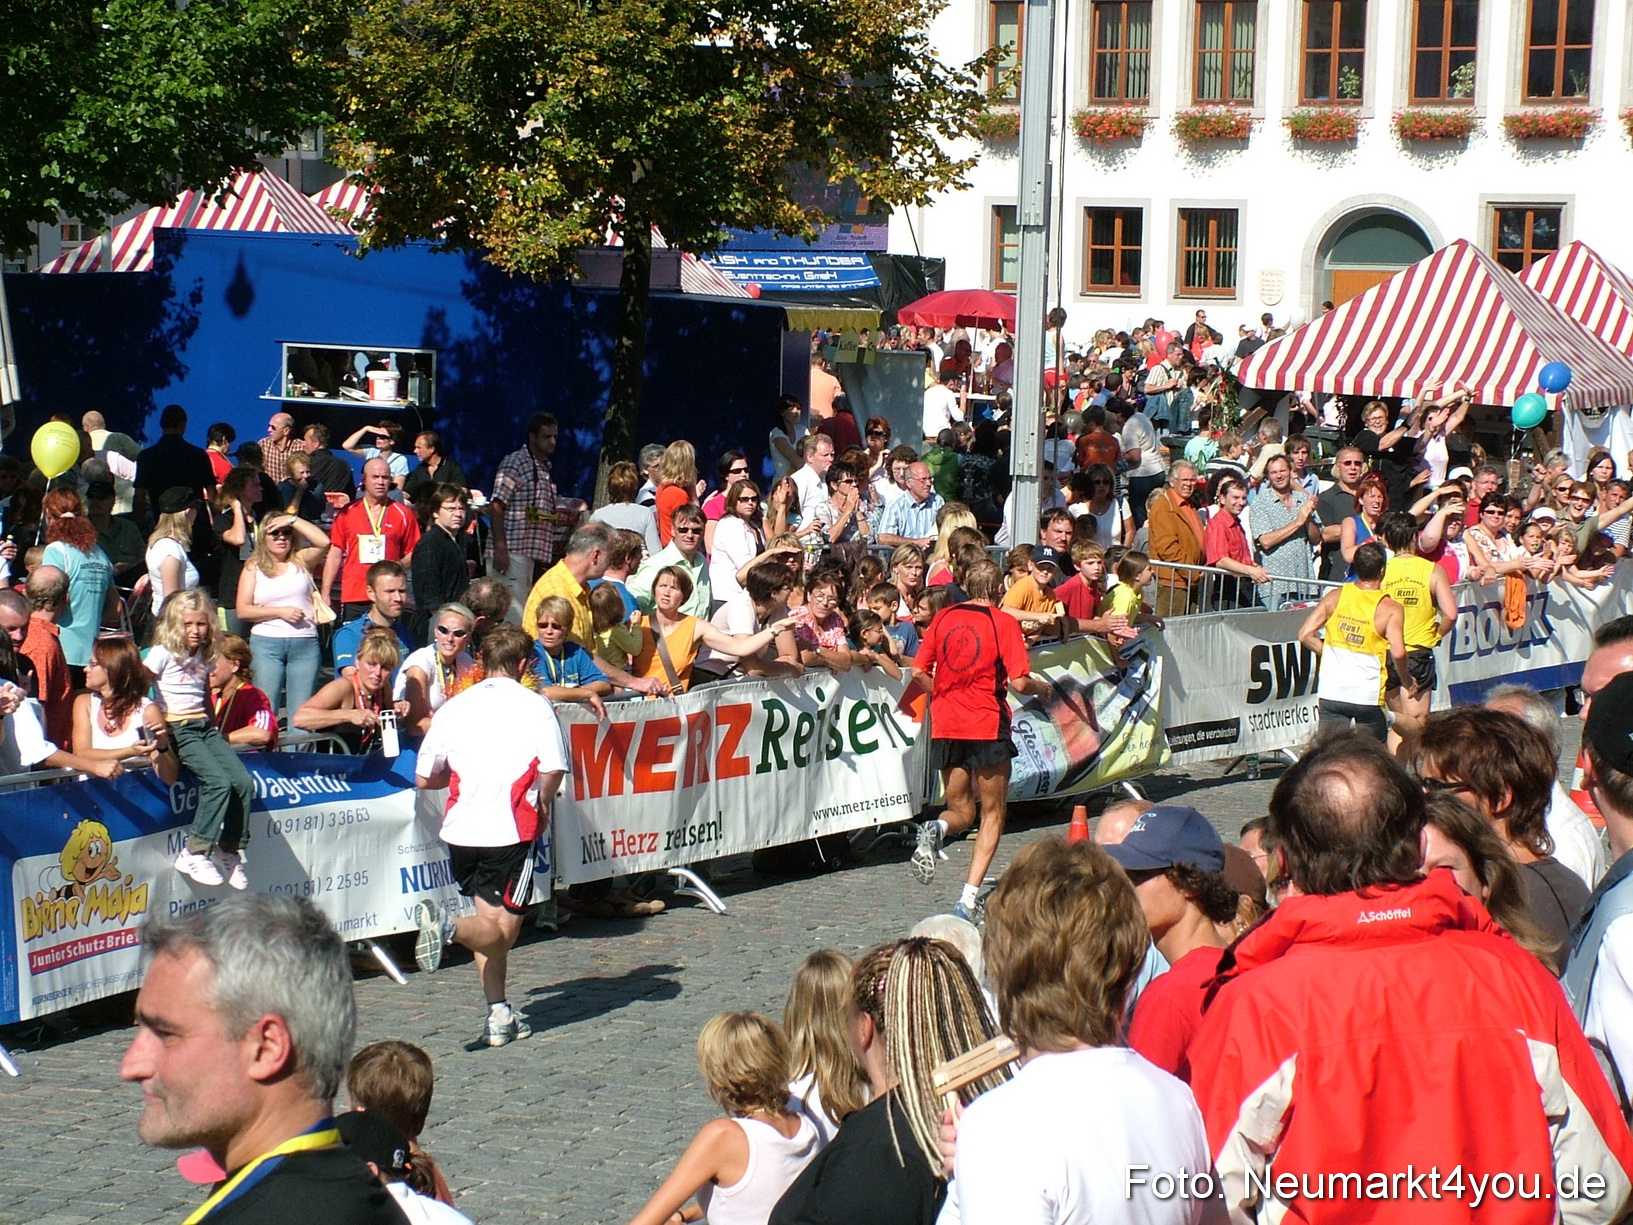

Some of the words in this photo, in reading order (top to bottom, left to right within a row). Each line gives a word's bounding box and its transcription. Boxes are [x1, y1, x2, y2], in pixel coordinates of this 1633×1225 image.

[780, 256, 865, 266] THUNDER
[1248, 704, 1309, 733] stadtwerke
[570, 702, 752, 802] MERZ
[755, 686, 915, 775] Reisen
[581, 831, 607, 865] Mit
[611, 828, 659, 859] Herz
[664, 810, 723, 851] reisen!
[21, 891, 81, 943] Biene
[81, 874, 149, 928] Maja
[169, 897, 216, 919] Pirne
[1368, 907, 1412, 922] Schöffel
